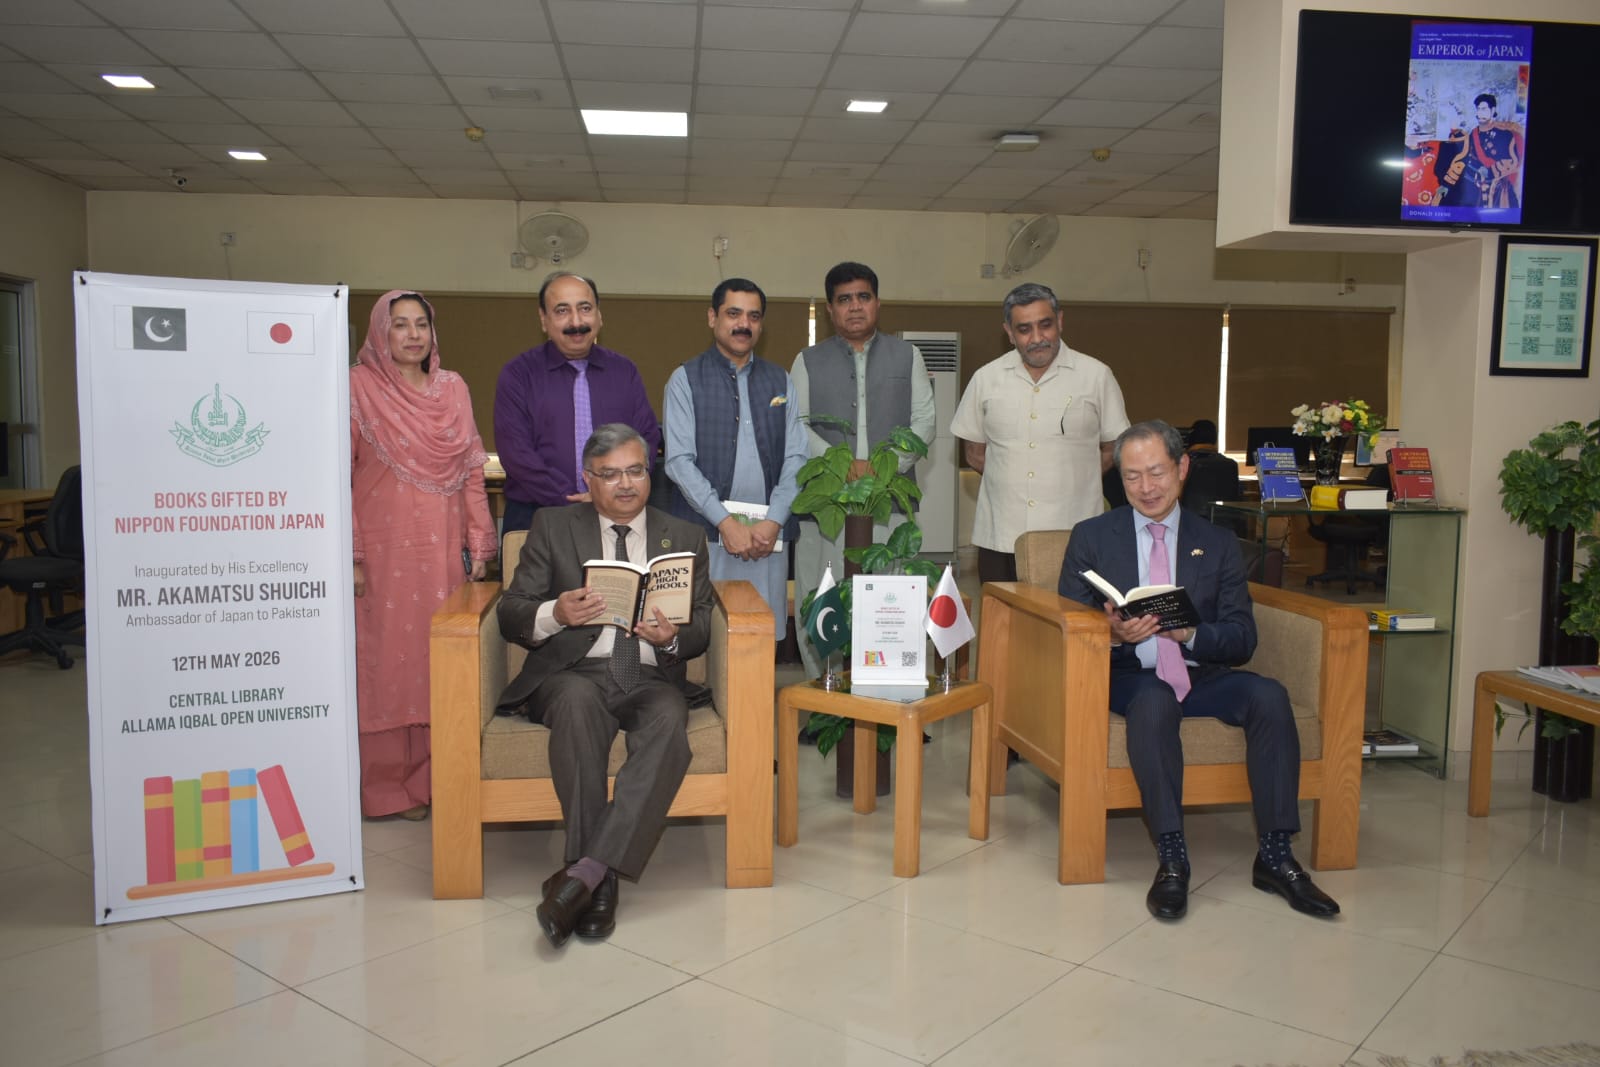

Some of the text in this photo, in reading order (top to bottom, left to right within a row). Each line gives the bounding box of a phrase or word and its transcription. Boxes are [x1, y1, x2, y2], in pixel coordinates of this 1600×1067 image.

[1418, 44, 1474, 56] EMPEROR
[1488, 45, 1524, 58] JAPAN
[155, 491, 287, 508] BOOKS GIFTED BY
[115, 514, 324, 533] NIPPON FOUNDATION JAPAN
[135, 561, 308, 579] Inaugurated by His Excellency
[656, 575, 678, 584] HIGH
[117, 581, 326, 607] MR. AKAMATSU SHUICHI
[126, 608, 319, 627] Ambassador of Japan to Pakistan
[172, 651, 280, 671] 12TH MAY 2026
[170, 687, 284, 708] CENTRAL LIBRARY
[122, 704, 329, 733] ALLAMA IQBAL OPEN UNIVERSITY
